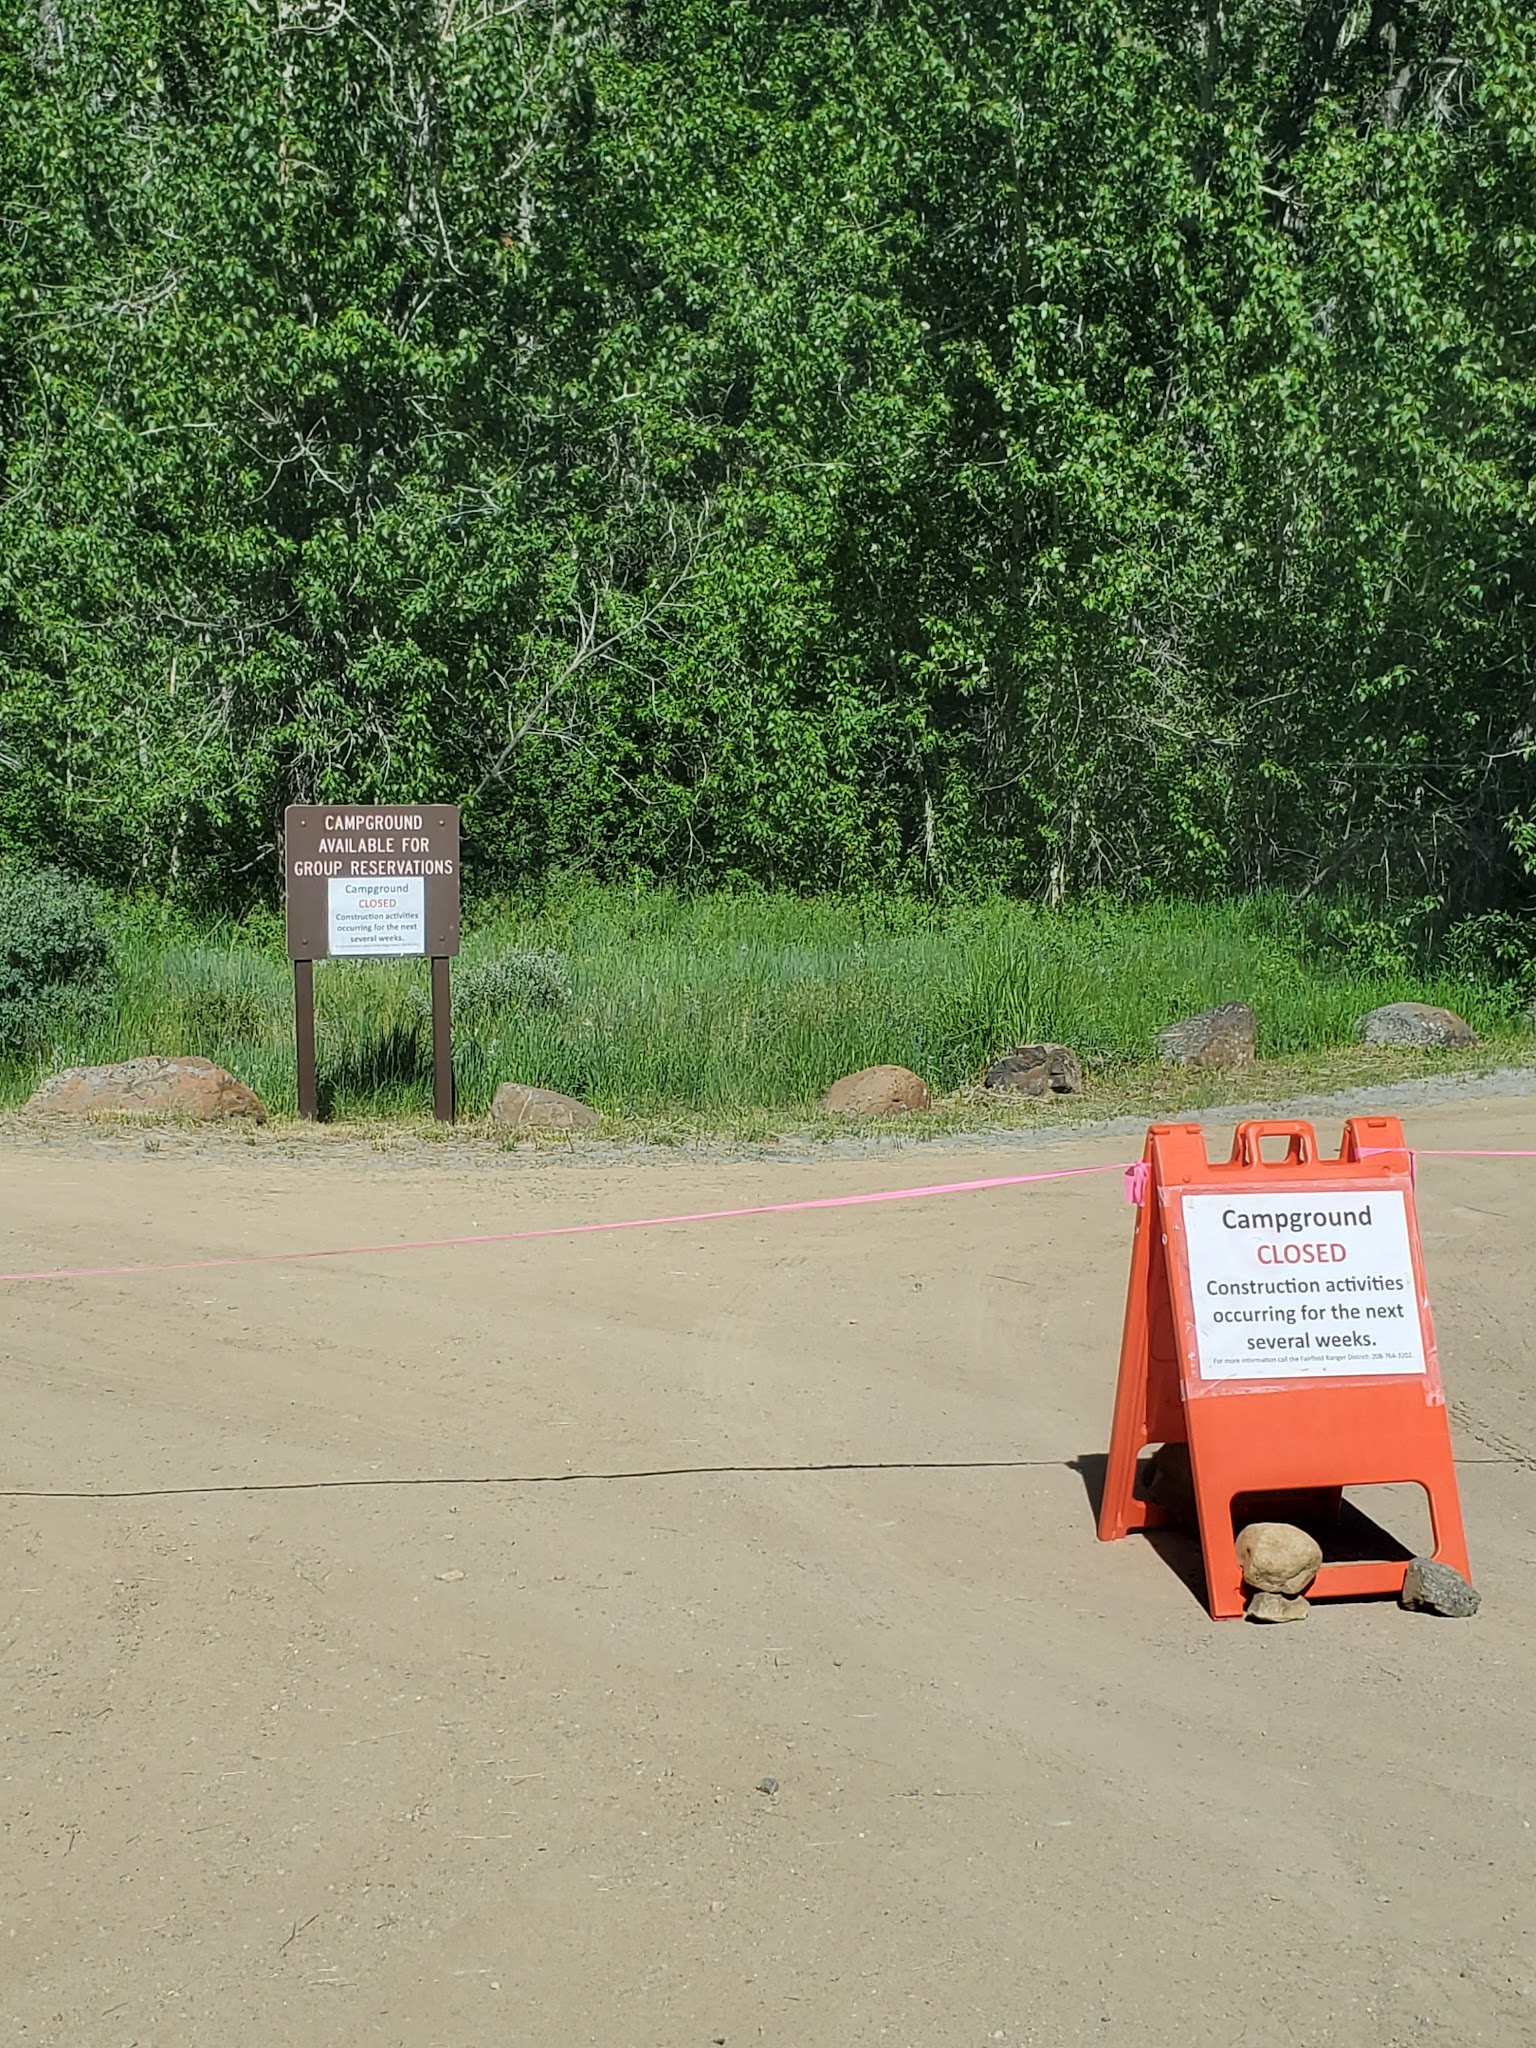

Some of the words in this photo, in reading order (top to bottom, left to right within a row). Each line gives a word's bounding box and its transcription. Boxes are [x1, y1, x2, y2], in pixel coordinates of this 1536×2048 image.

[324, 814, 423, 831] CAMPGROUND
[318, 837, 395, 853] AVAILABLE
[402, 837, 430, 853] FOR
[294, 860, 343, 876] GROUP
[350, 859, 453, 875] RESERVATIONS
[345, 883, 409, 895] Campground
[358, 898, 397, 908] CLOSED
[335, 913, 384, 921] Construction
[385, 912, 419, 920] activities
[336, 924, 372, 932] occurring
[373, 923, 385, 931] for
[386, 923, 399, 931] the
[350, 934, 377, 942] several
[378, 934, 405, 942] weeks.
[1221, 1204, 1373, 1233] Campground
[1257, 1242, 1347, 1265] CLOSED
[1206, 1278, 1321, 1296] Construction
[1325, 1275, 1404, 1293] activities
[1212, 1305, 1297, 1325] occurring
[1300, 1304, 1327, 1321] for
[1331, 1303, 1361, 1320] the
[1365, 1303, 1405, 1319] next
[1246, 1332, 1310, 1350] several
[1315, 1330, 1377, 1349] weeks.
